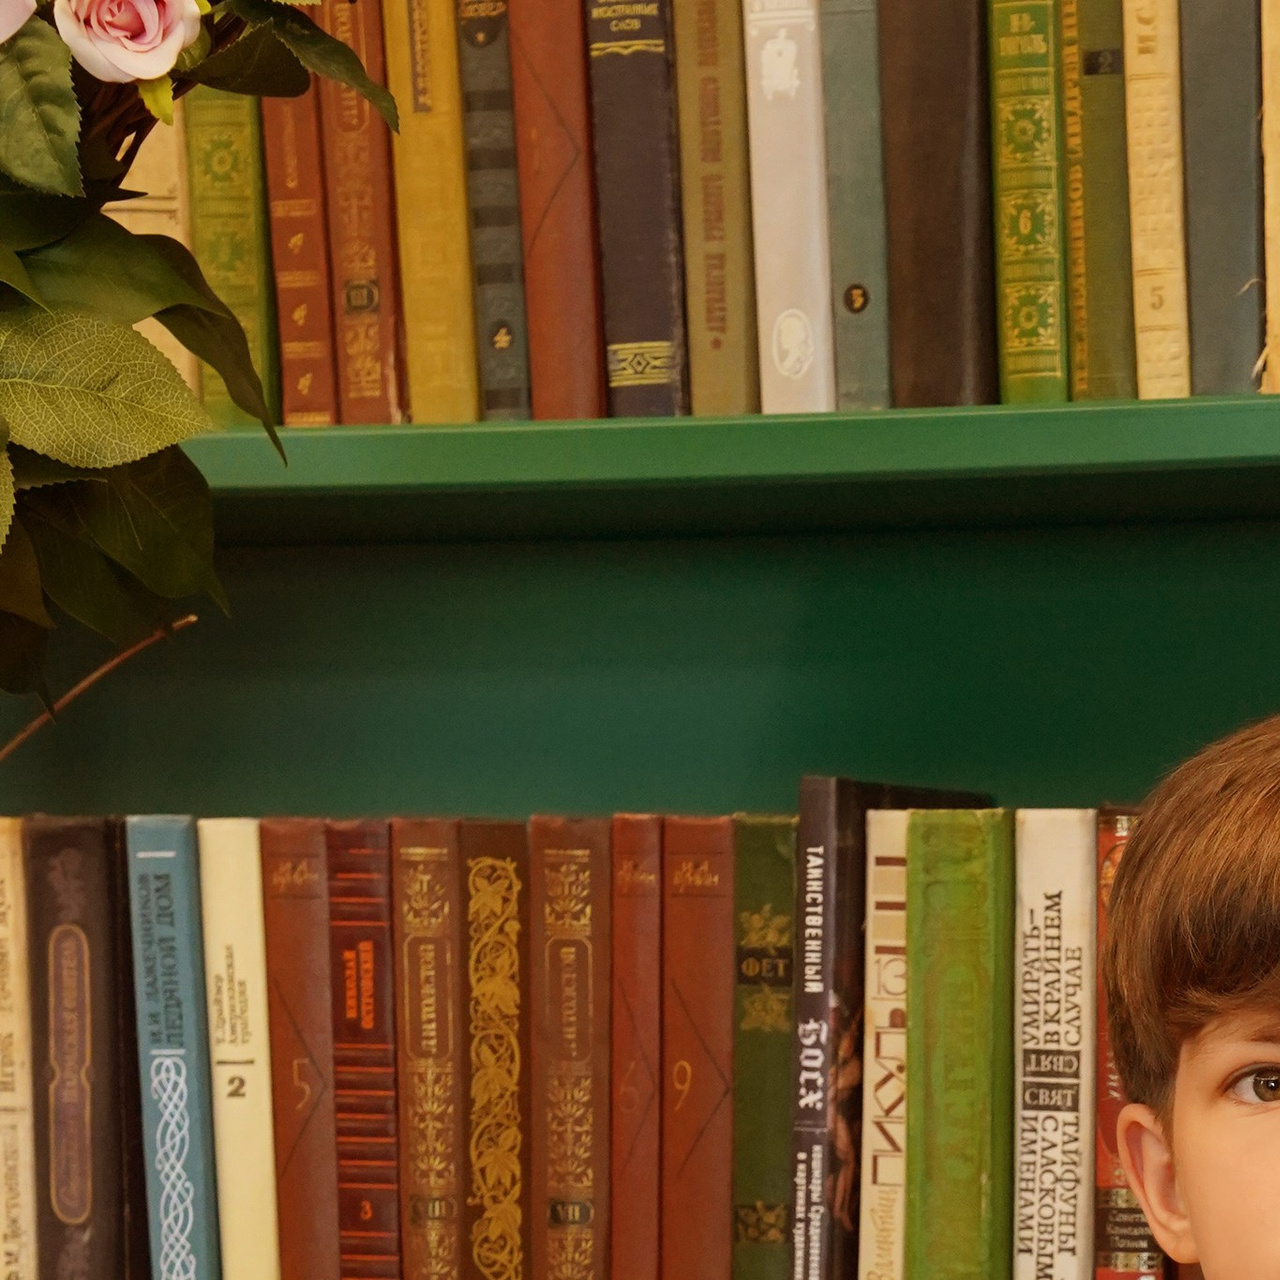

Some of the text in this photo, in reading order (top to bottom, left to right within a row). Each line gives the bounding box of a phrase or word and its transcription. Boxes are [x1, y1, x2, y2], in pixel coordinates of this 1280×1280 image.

[609, 18, 642, 32] СЛОВ
[1149, 285, 1165, 311] 5
[137, 872, 159, 1004] ЛАЖЕЧНИКОВ
[803, 845, 826, 994] ТАИНСТВЕННЫЙ
[153, 872, 184, 1048] ЛЕДЯНОЙ ДОМ
[741, 956, 787, 977] ФЕТ
[1042, 889, 1064, 1047] В КРАЙНЕМ
[1064, 946, 1082, 1047] СЛУЧАЕ
[226, 1075, 247, 1098] 2
[292, 1057, 311, 1111] 5
[672, 1060, 693, 1112] 9
[1025, 1054, 1079, 1073] СВЯТ
[1024, 1087, 1076, 1107] СВЯТ
[1040, 1115, 1059, 1132] С
[794, 1162, 808, 1220] картинах
[808, 1144, 823, 1203] кошмары
[1017, 1115, 1038, 1257] ИМЕНАМИ
[1058, 1115, 1083, 1257] ТАЙФУНЫ
[360, 1199, 373, 1221] 3
